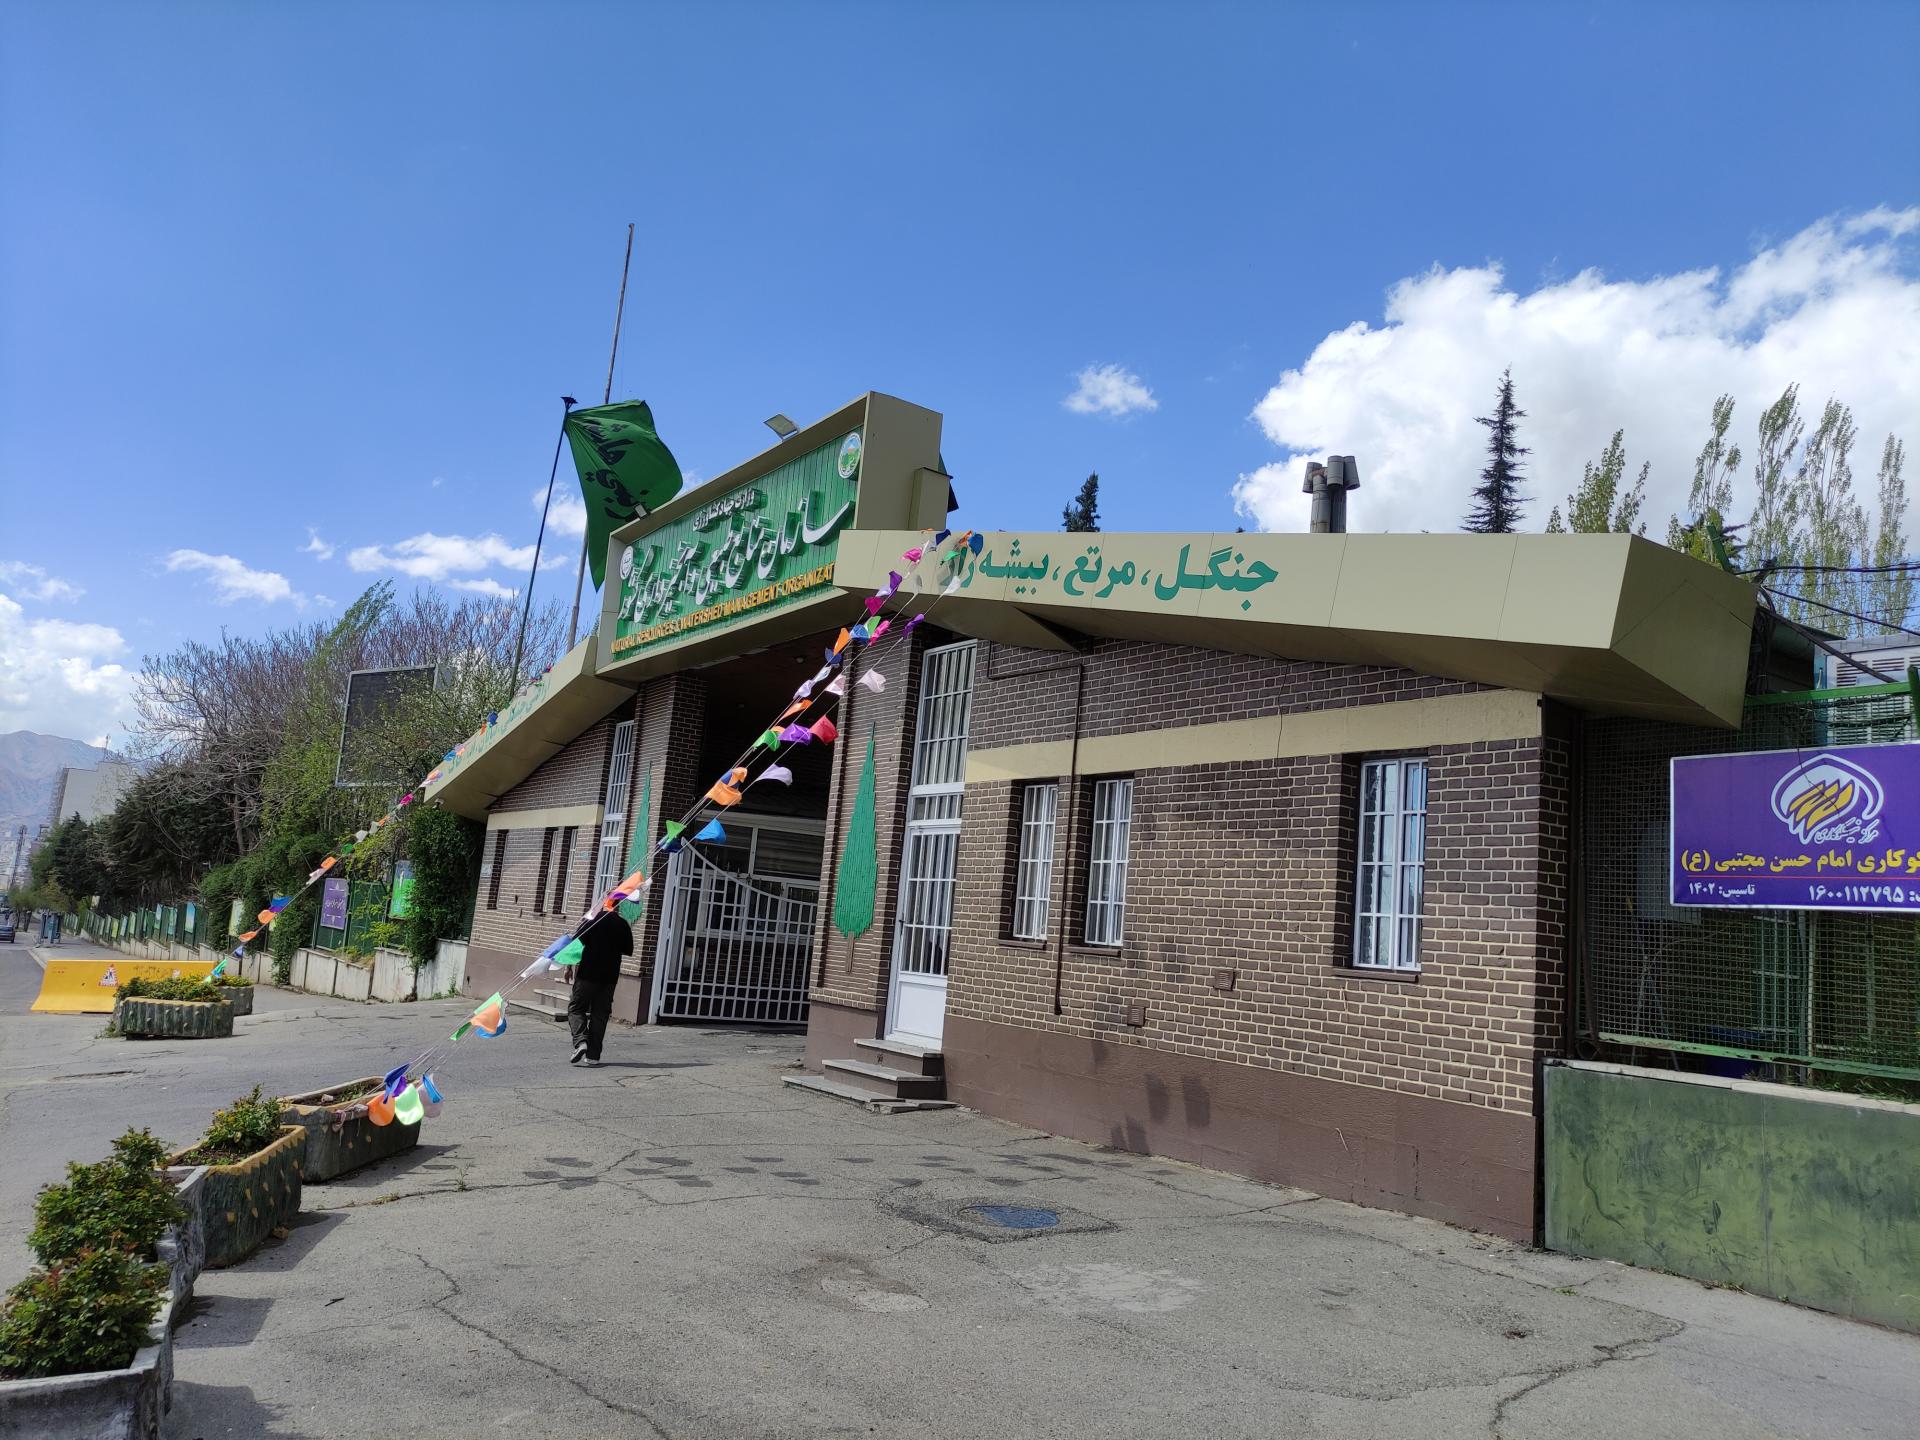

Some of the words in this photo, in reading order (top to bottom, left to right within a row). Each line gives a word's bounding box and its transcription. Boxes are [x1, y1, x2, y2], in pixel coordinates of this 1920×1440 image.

[693, 501, 721, 532] کشاورزی
[719, 497, 735, 516] جهاد
[757, 490, 851, 580] سازمان
[695, 514, 735, 605] طبیعی
[725, 516, 766, 588] منابع
[617, 546, 654, 620] کشور
[680, 603, 723, 630] WATERSHED
[722, 582, 780, 617] MANAGEMENT
[1681, 849, 1711, 872] (ع)
[1714, 852, 1766, 873] مجتبی
[1769, 852, 1812, 873] حسن
[1816, 849, 1852, 872] امام
[1688, 882, 1715, 895] ۱۴۰۲
[1718, 883, 1756, 898] تاسیس:
[1808, 885, 1905, 903] ۱۶۰۰۱۱۲۷۹۵
